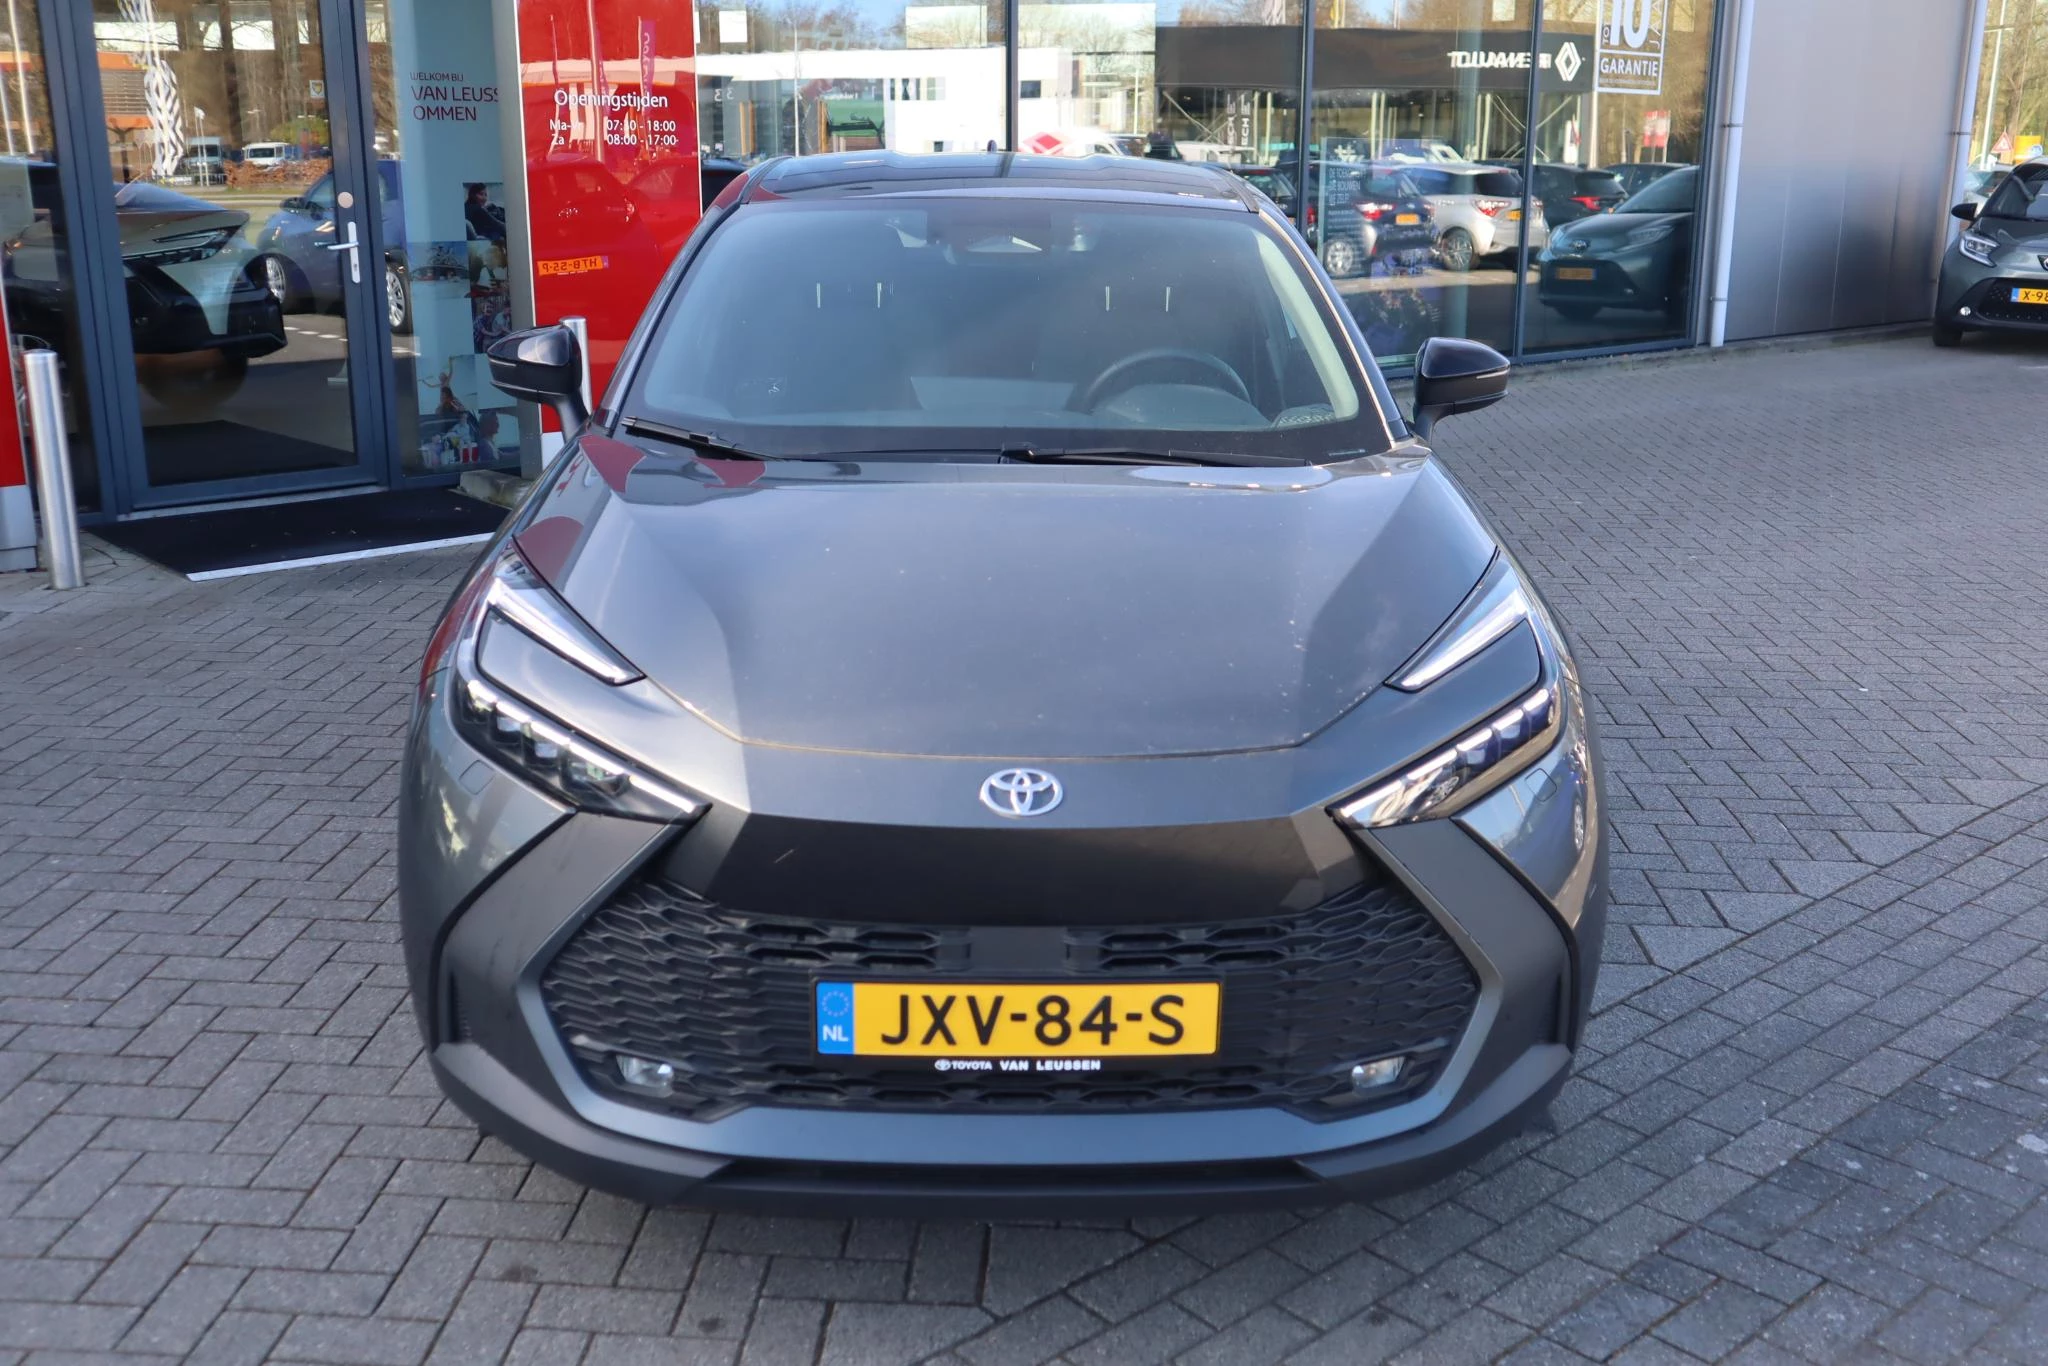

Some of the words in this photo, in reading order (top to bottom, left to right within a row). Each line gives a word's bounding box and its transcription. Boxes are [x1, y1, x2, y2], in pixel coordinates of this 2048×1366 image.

[1610, 0, 1651, 49] 10
[1649, 0, 1661, 49] JAA
[1600, 58, 1659, 77] GARANTIE
[410, 71, 449, 81] WELKOM
[411, 86, 447, 101] VAN
[554, 89, 668, 111] Openingstijden
[413, 105, 477, 121] OMMEN
[647, 120, 676, 131] 18:00
[551, 134, 565, 145] Za
[606, 134, 637, 145] 08:00
[648, 134, 677, 146] 17:00
[881, 994, 1185, 1046] JXV-84-S
[822, 1025, 849, 1042] NL
[951, 1060, 993, 1071] TOYOTA
[1000, 1060, 1029, 1071] VAN
[1036, 1059, 1101, 1071] LEUSSEN
